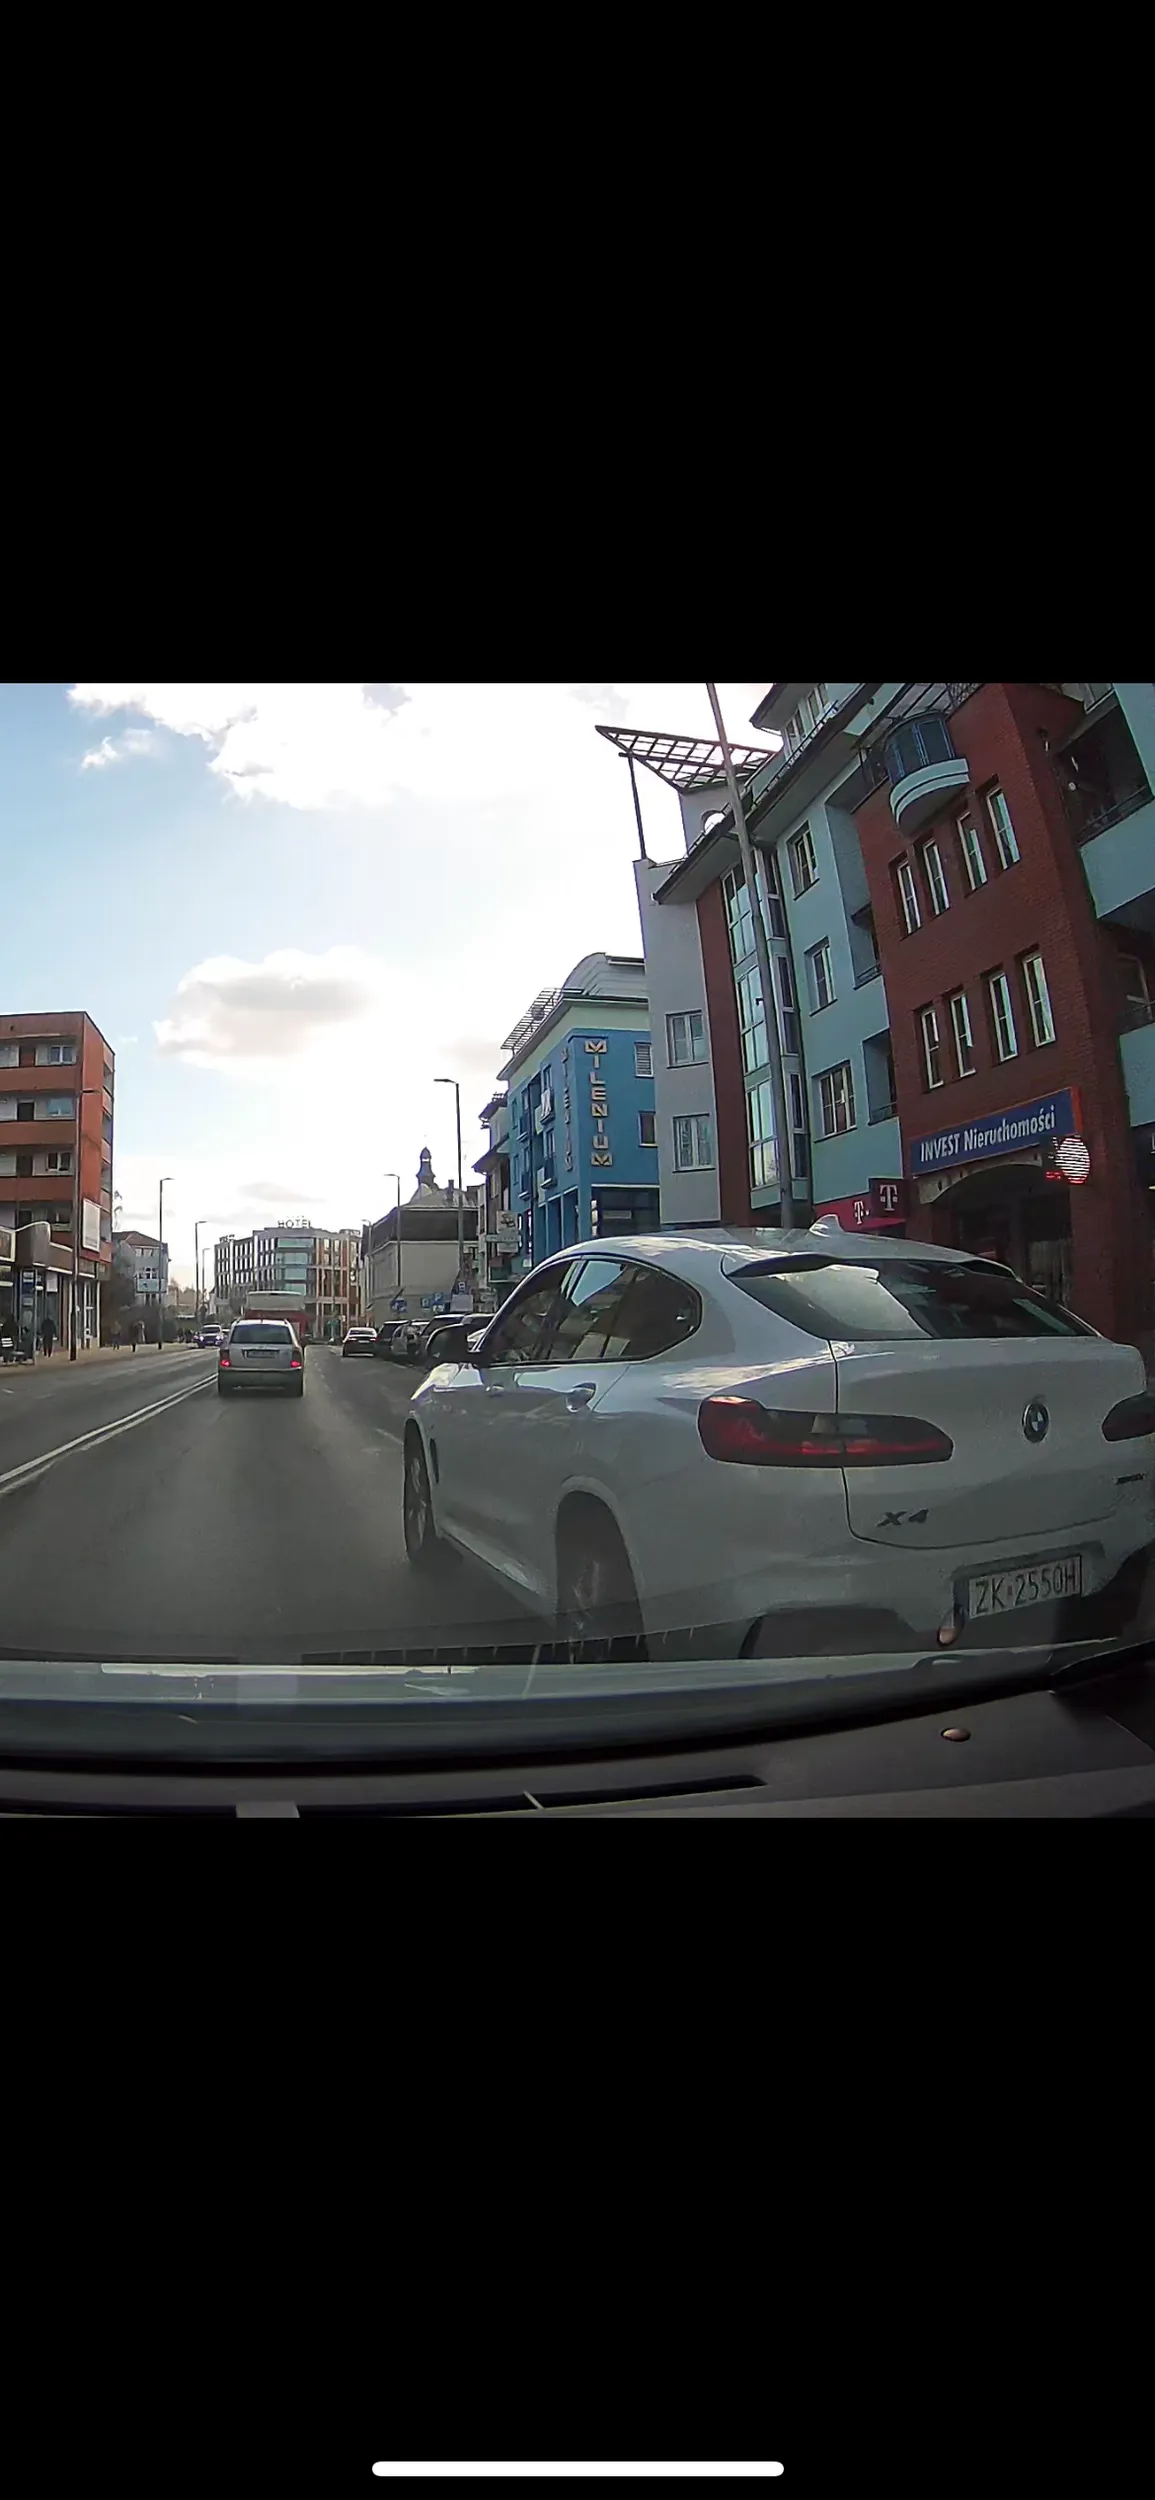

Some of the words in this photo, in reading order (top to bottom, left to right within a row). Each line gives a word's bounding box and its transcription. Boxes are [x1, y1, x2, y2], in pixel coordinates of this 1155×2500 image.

[584, 1040, 613, 1167] MILENIUM
[920, 1132, 961, 1163] INVEST
[963, 1104, 1056, 1152] Nieruchomości
[277, 1219, 313, 1229] HOTEL
[876, 1508, 929, 1528] X4
[975, 1577, 1005, 1615] ZK
[1014, 1561, 1077, 1606] 2550H
